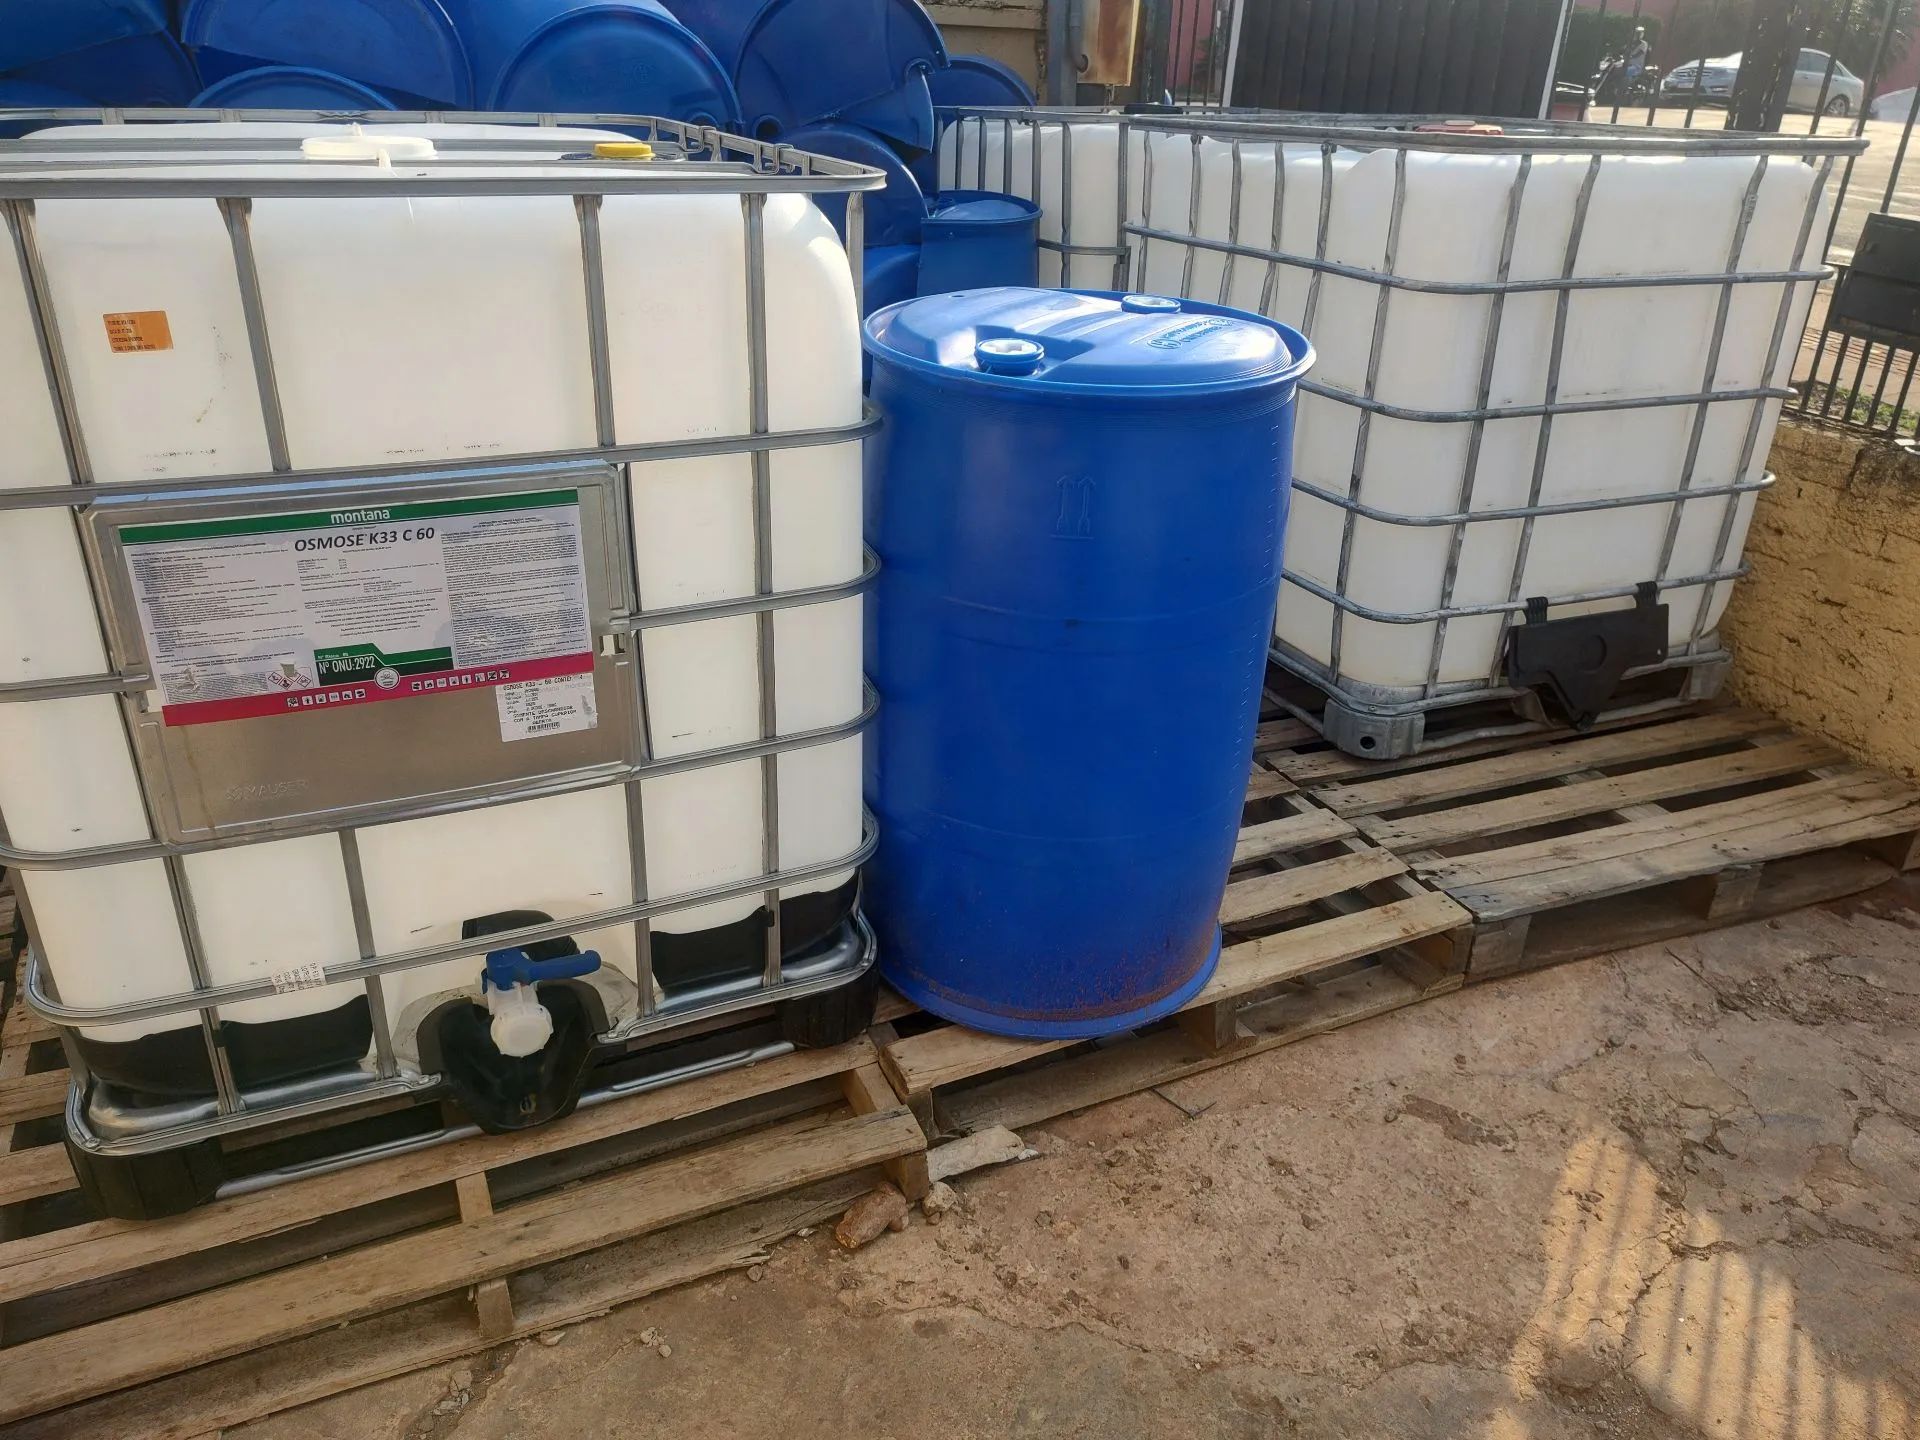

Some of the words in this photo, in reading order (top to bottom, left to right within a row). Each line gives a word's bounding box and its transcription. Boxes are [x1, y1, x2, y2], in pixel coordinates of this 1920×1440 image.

[330, 508, 390, 524] montana
[294, 534, 365, 552] OSMOSE
[369, 530, 398, 545] K33
[402, 529, 412, 542] C
[416, 527, 435, 540] 60
[332, 656, 375, 672] ONU:2922
